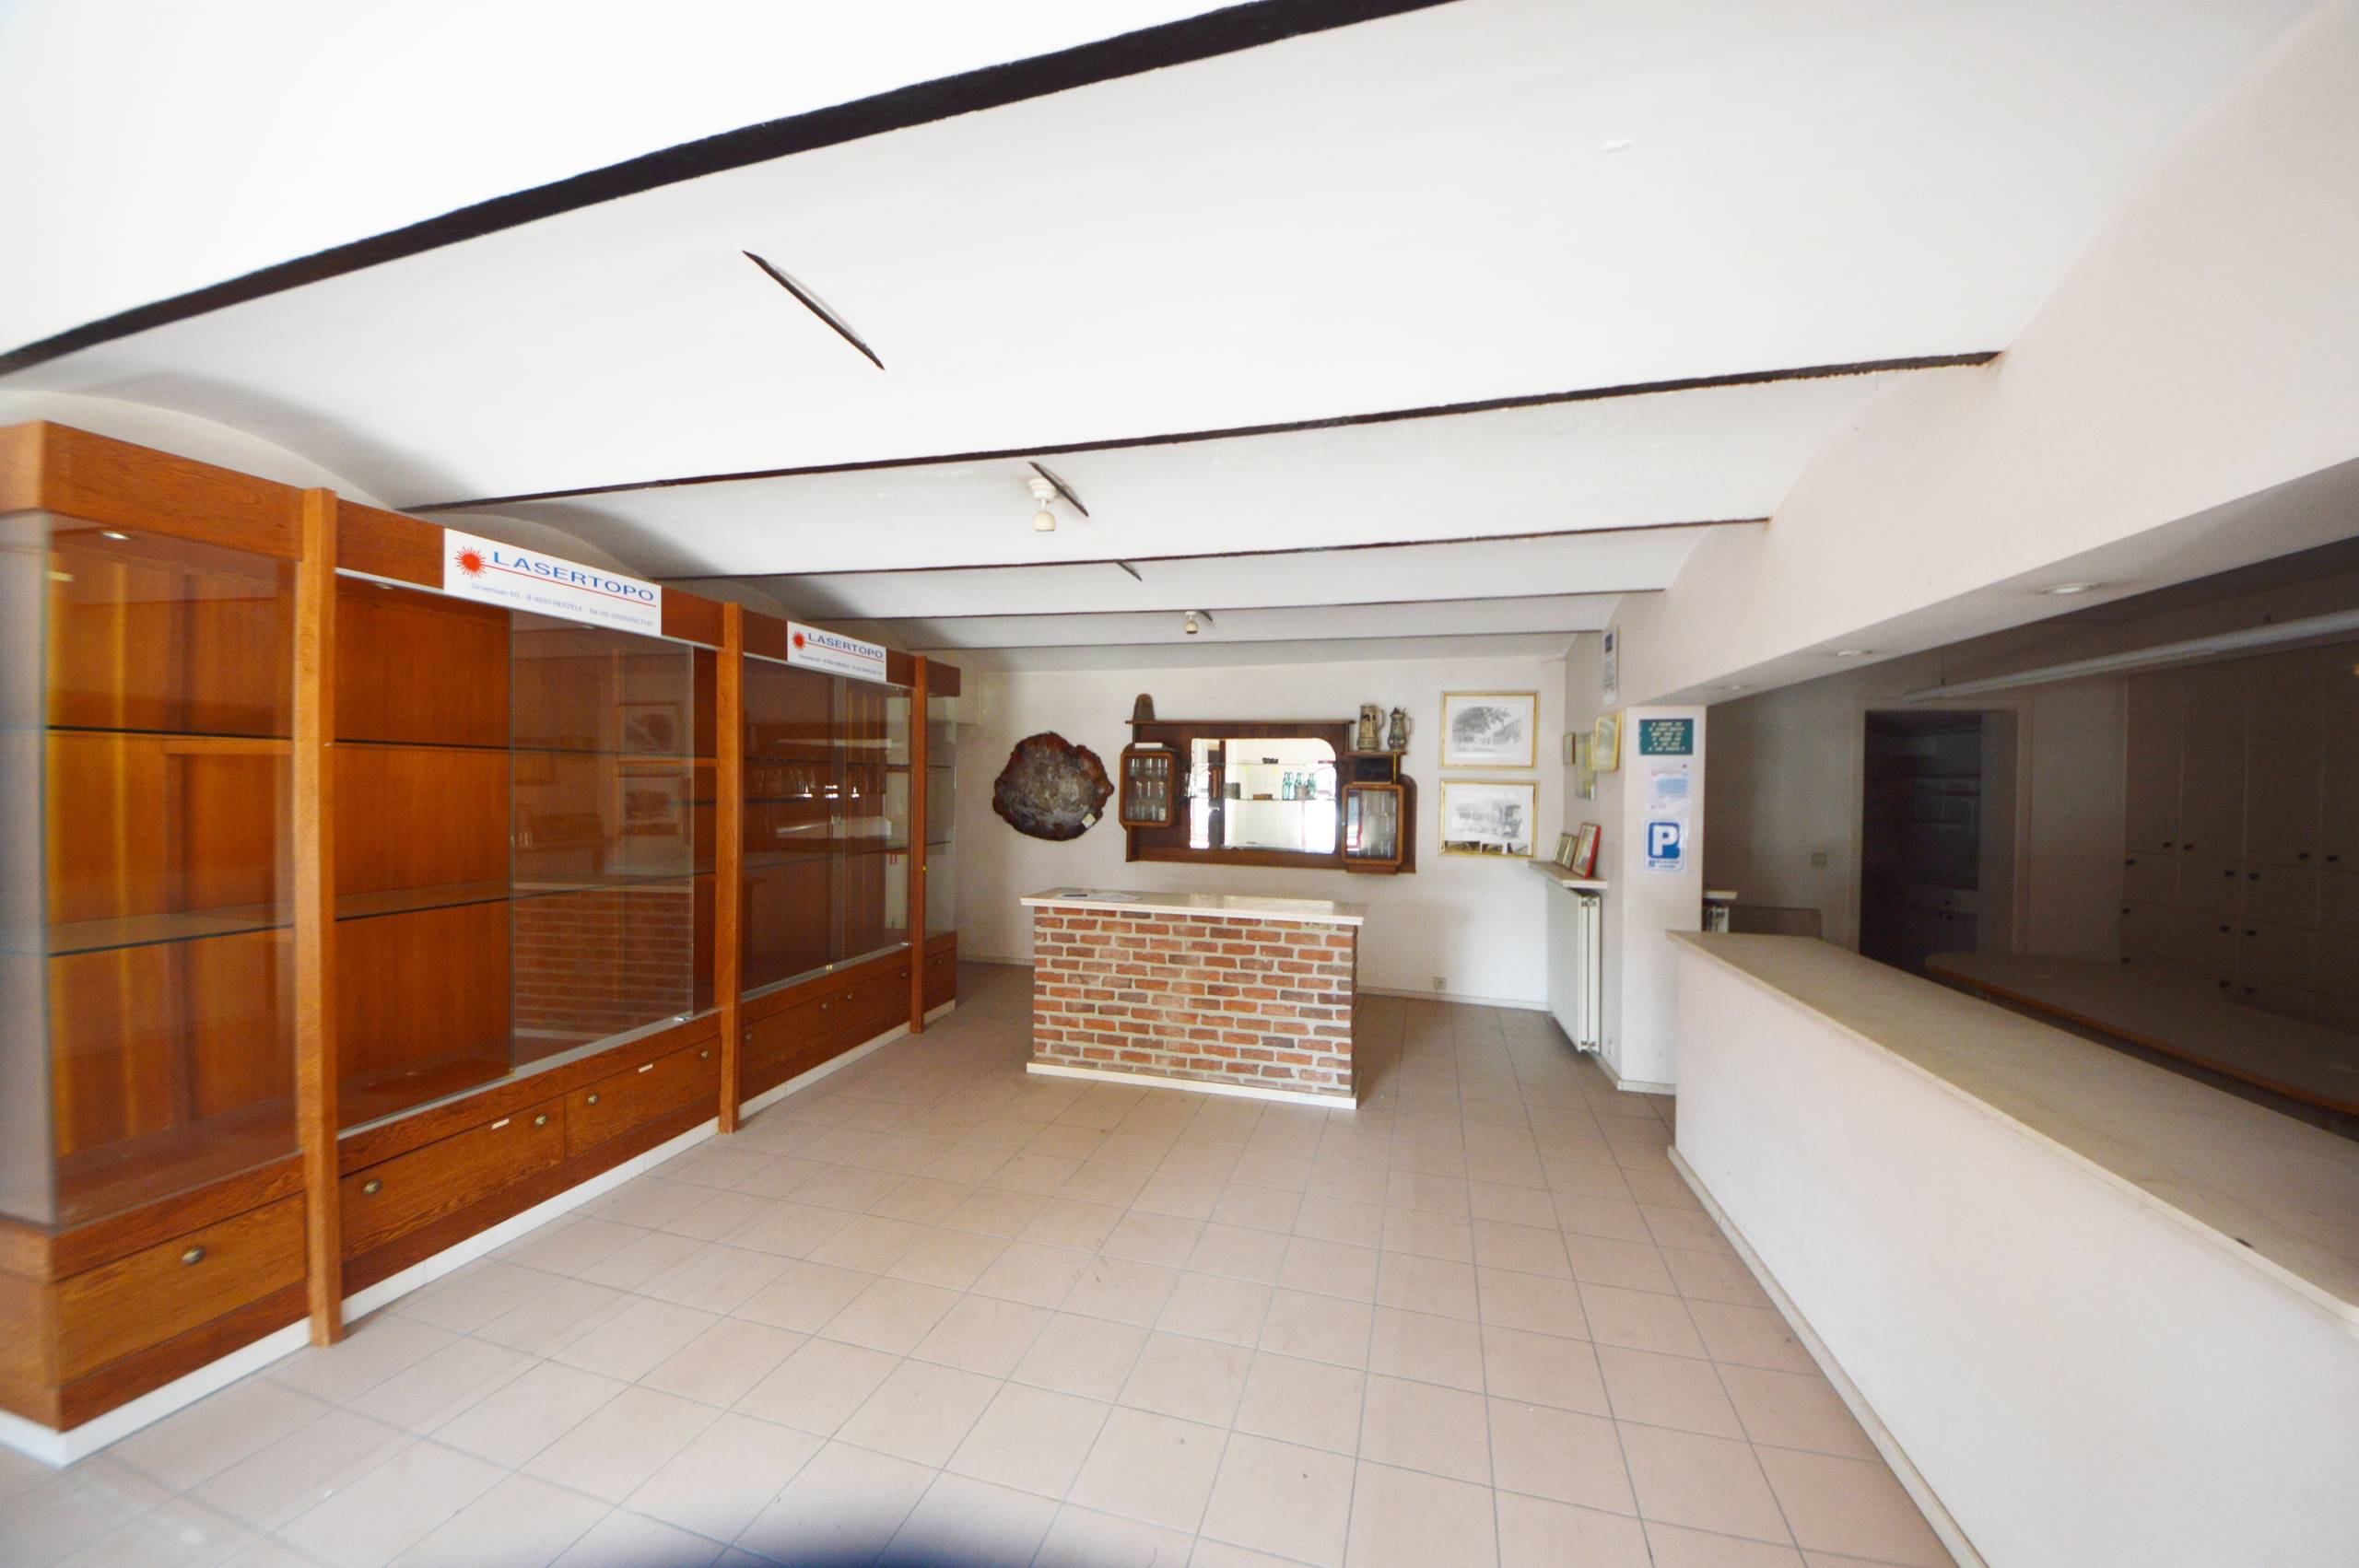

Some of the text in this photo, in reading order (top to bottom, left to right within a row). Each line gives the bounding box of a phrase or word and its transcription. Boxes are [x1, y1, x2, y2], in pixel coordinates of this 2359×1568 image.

[494, 551, 654, 602] LASERTOPO
[808, 632, 883, 659] LASERTOPO
[1652, 825, 1678, 856] P
